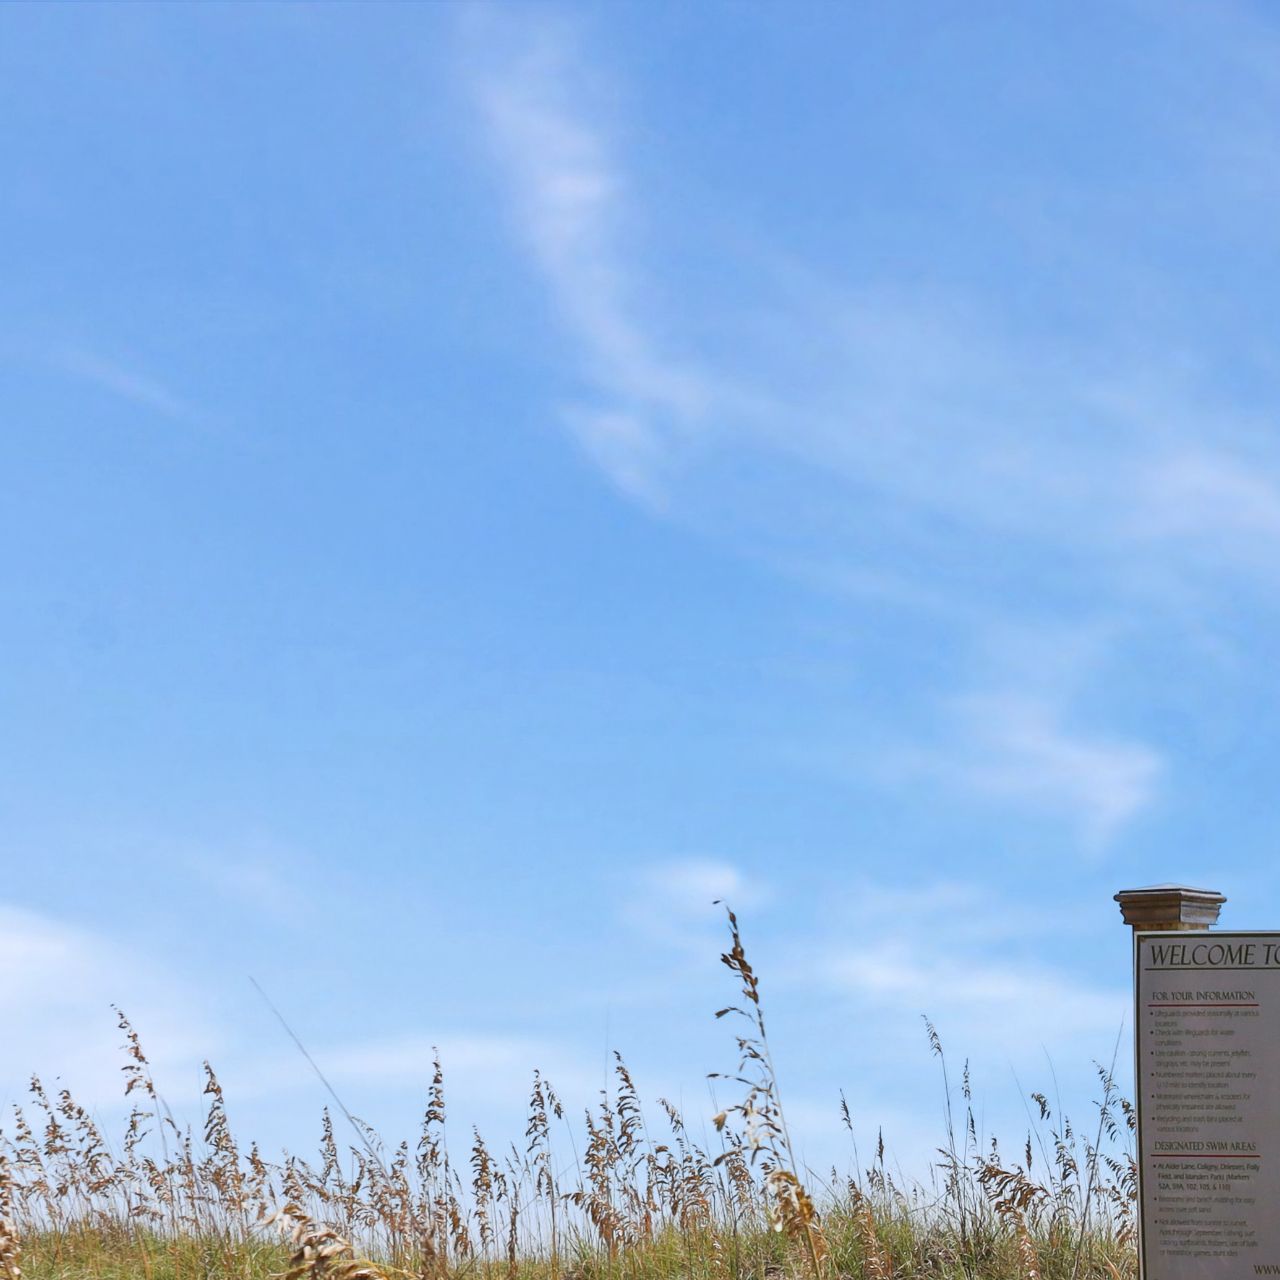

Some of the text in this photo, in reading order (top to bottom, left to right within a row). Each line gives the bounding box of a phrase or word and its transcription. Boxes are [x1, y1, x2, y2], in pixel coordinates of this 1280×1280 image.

[1151, 944, 1256, 965] WELCOME
[1152, 991, 1255, 1000] FOR YOUR INFORMATION
[1154, 1141, 1256, 1151] DESIGNATED SWIM AREAS
